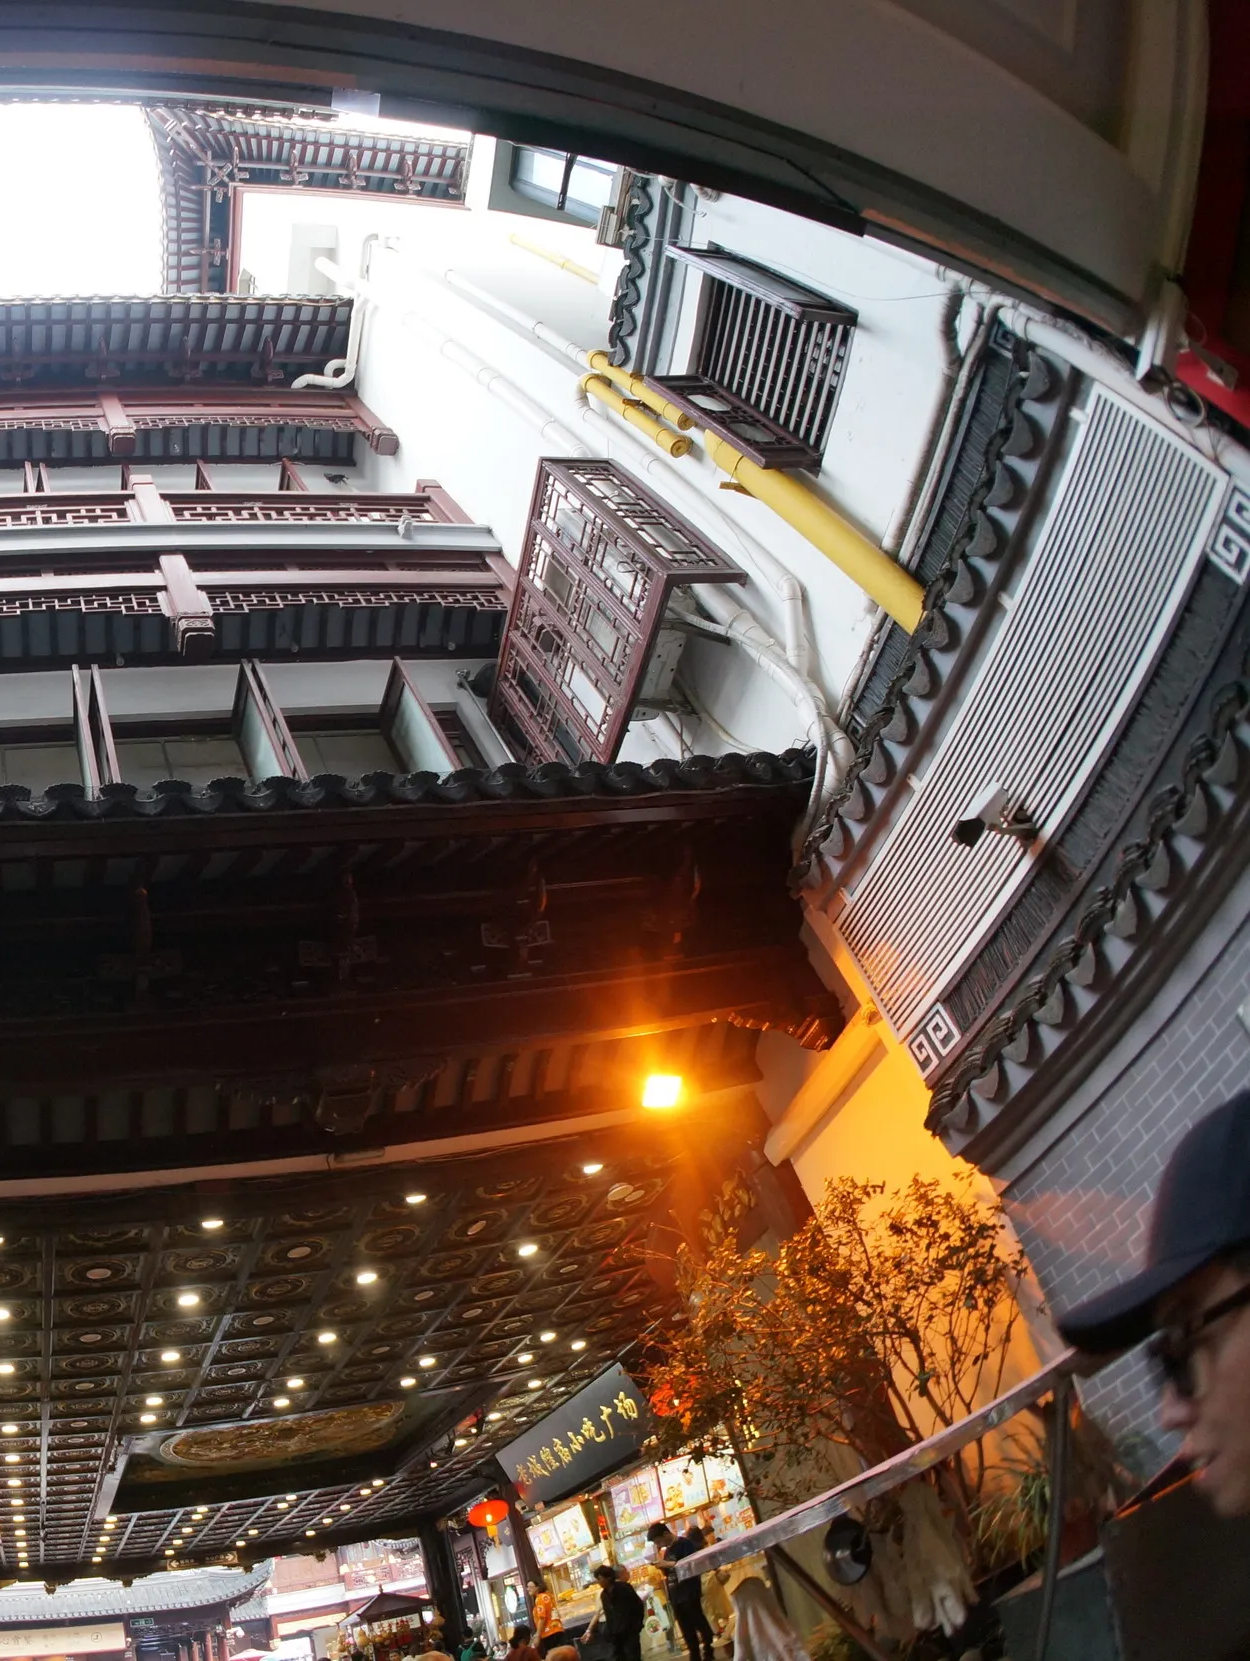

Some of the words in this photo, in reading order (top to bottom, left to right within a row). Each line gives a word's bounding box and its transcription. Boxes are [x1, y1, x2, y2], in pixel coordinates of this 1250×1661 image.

[515, 1390, 638, 1486] 老城隍庙小吃广场
